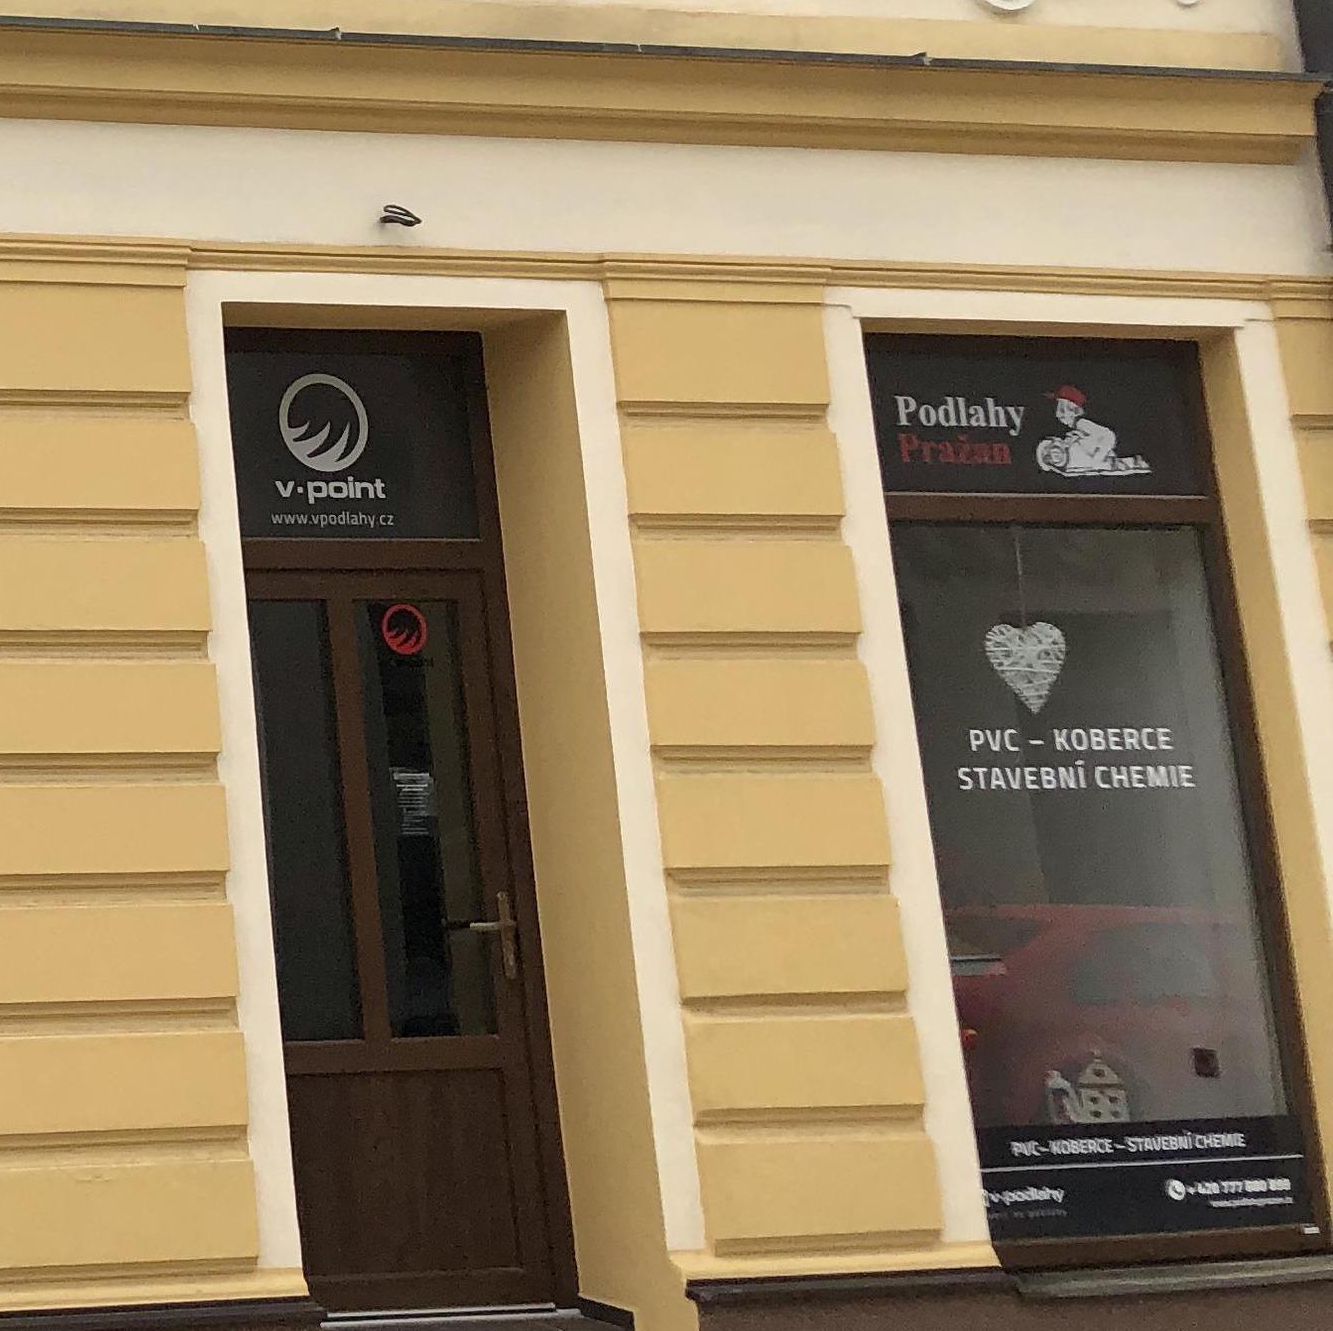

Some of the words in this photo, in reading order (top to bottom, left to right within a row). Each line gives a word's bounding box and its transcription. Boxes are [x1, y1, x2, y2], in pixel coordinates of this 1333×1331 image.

[893, 395, 1025, 436] Podlahy
[898, 433, 1012, 464] Pražan
[271, 511, 394, 528] www.vpodlahy.cz
[969, 729, 1020, 751] PVC
[1053, 728, 1174, 751] KOBERCE
[957, 759, 1087, 790] STAVEBNÍ
[1094, 765, 1196, 789] CHEMIE
[1010, 1140, 1040, 1157] PVC
[1049, 1137, 1114, 1155] KOBERCE
[1195, 1132, 1246, 1149] CHEMIE
